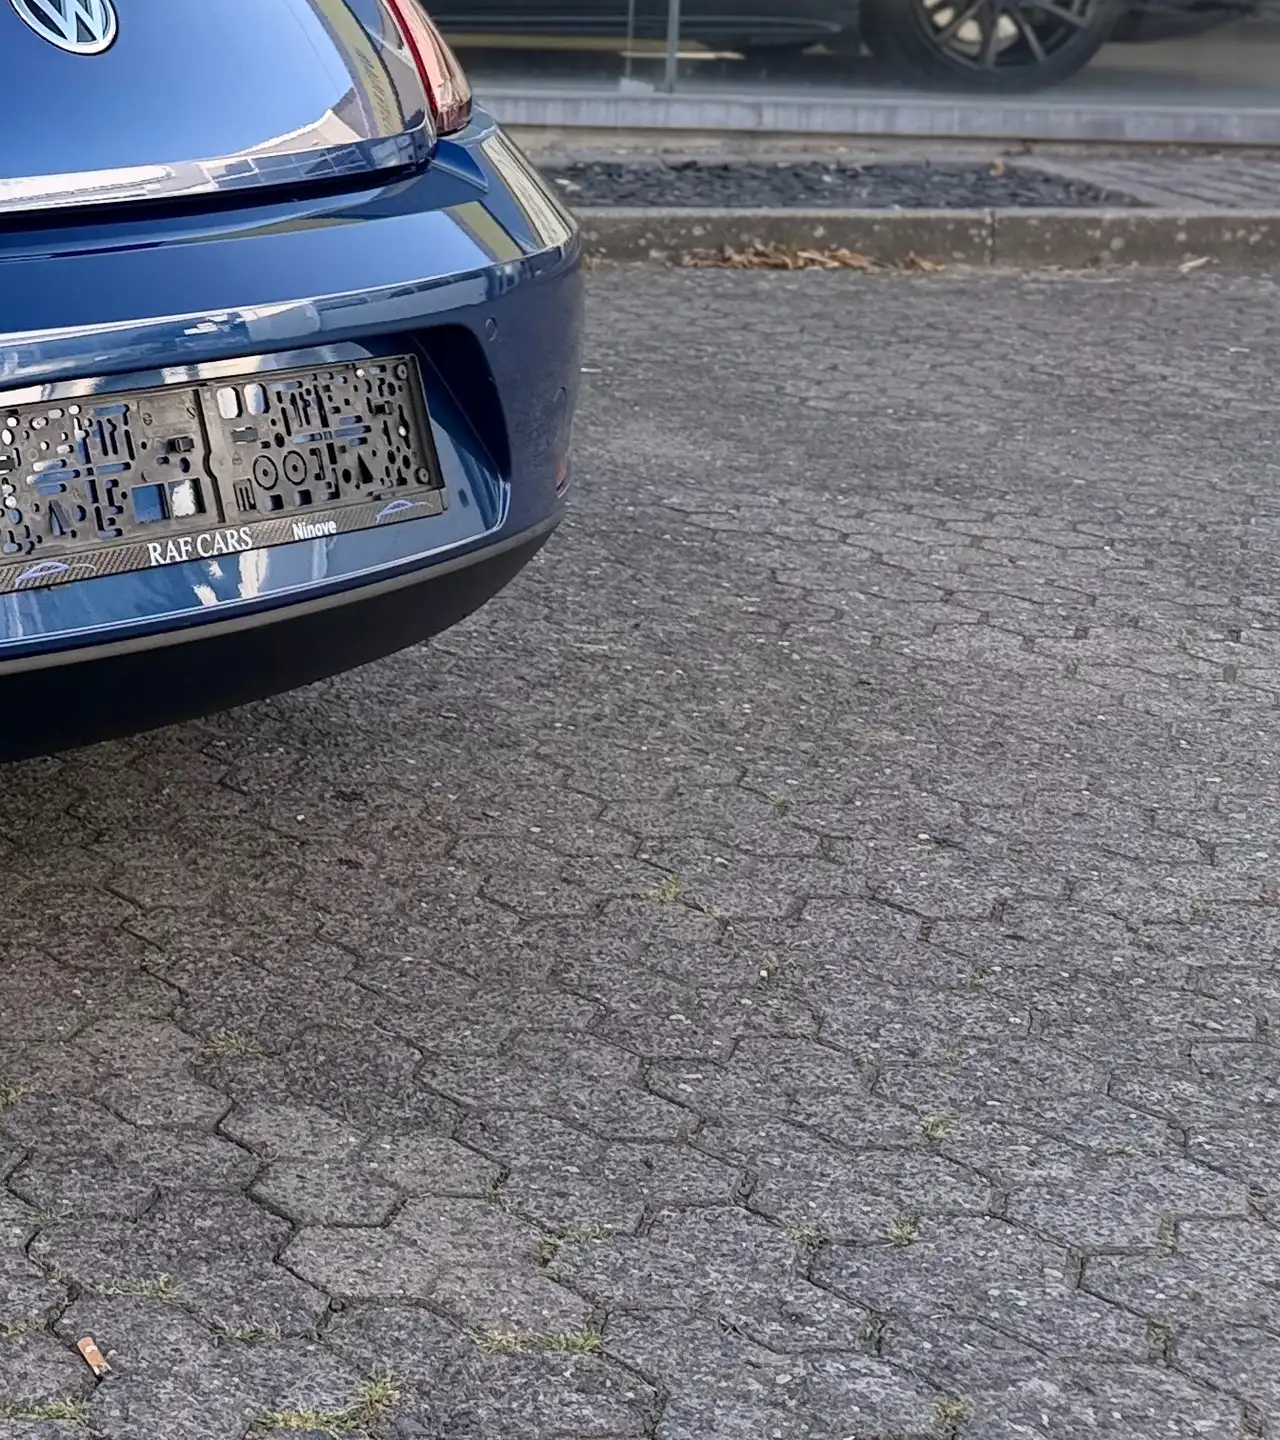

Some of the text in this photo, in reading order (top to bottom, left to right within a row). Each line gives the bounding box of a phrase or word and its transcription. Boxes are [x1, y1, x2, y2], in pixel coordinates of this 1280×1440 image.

[147, 520, 337, 566] RAF CARS Ninove
